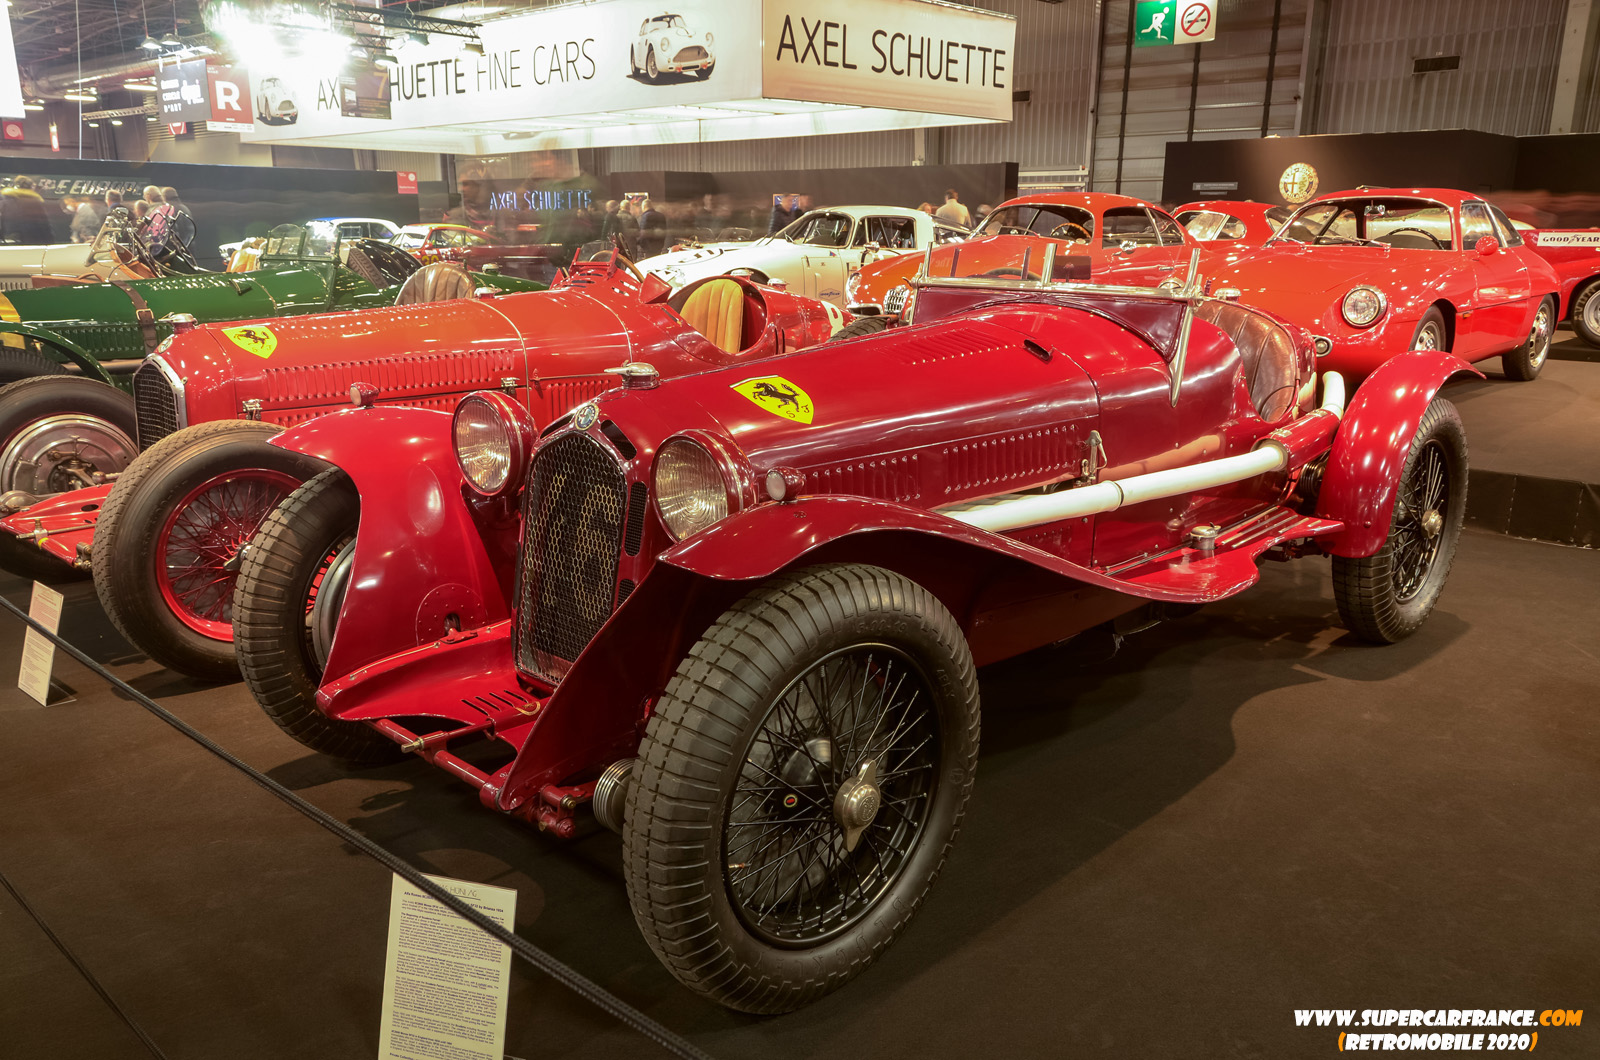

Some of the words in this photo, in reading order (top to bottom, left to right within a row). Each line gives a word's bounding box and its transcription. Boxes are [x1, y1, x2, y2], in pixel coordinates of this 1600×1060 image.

[317, 77, 340, 111] AX
[388, 58, 466, 102] HUETTE
[476, 50, 521, 93] FINE
[533, 38, 596, 86] CARS
[776, 13, 857, 70] AXEL
[871, 29, 1006, 89] SCHUETTE
[214, 80, 243, 111] R
[489, 191, 520, 211] AXEL
[523, 190, 592, 211] SCHUETTE
